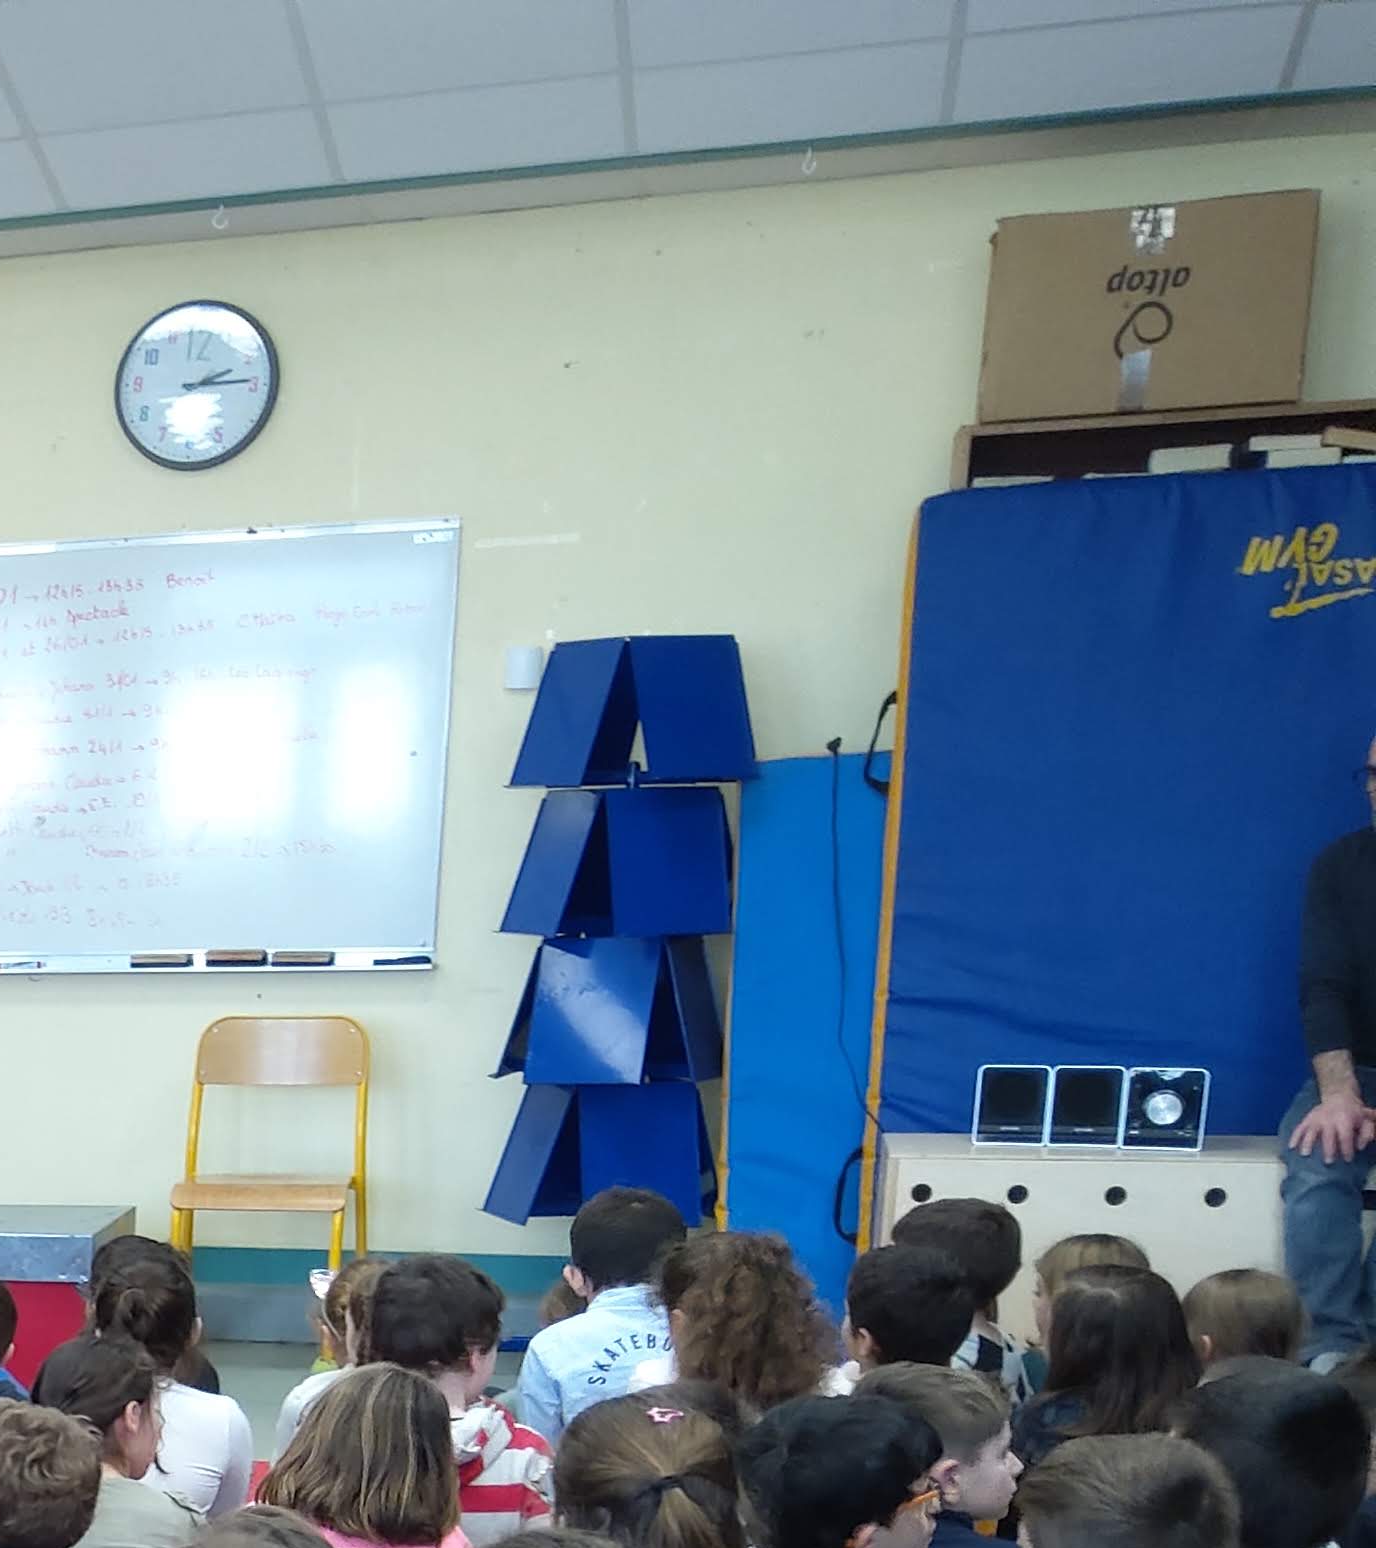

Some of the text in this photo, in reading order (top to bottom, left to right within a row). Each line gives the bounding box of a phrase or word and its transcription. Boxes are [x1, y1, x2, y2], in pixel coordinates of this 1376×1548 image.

[1106, 265, 1191, 294] altop
[144, 349, 159, 365] 10
[133, 376, 144, 393] 9
[1240, 522, 1339, 575] GYM
